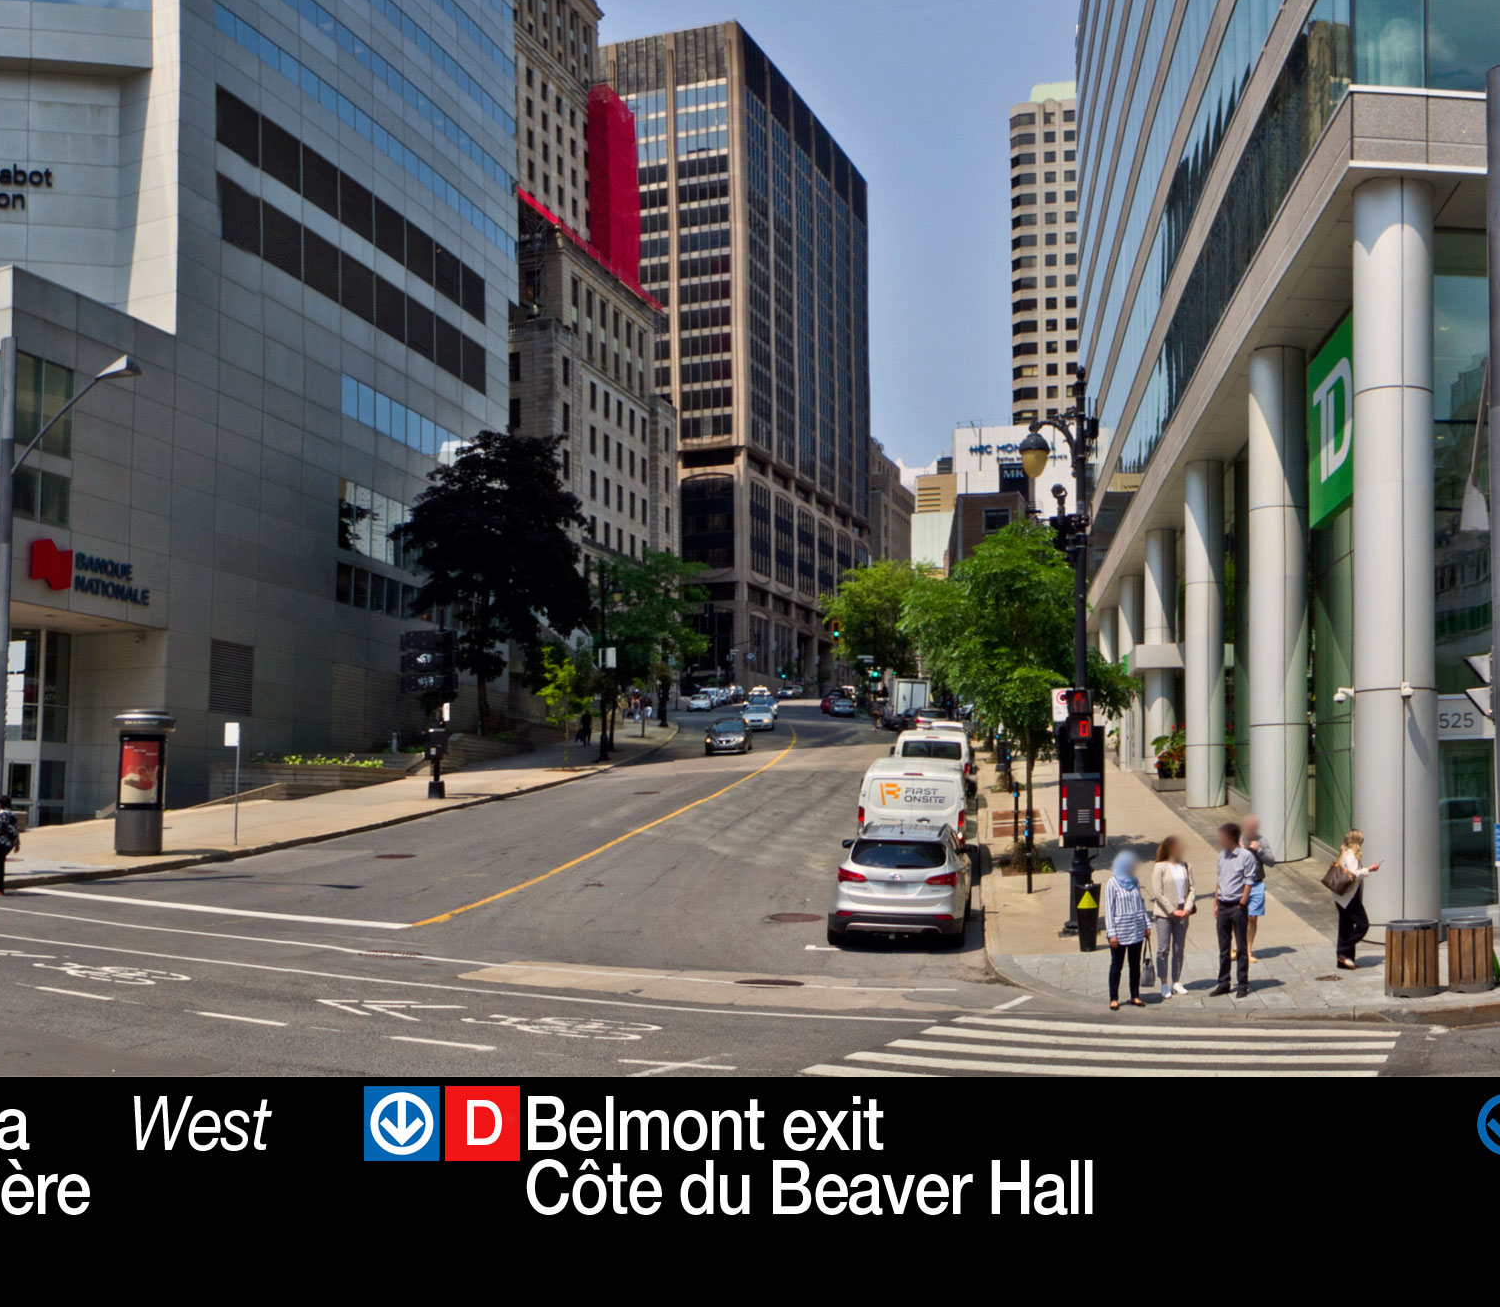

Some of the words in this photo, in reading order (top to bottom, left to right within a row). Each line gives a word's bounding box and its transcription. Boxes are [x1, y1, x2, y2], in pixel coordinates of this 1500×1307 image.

[1313, 357, 1353, 484] TD
[75, 552, 133, 581] BANQUE
[74, 575, 150, 606] NATIONALE
[1439, 712, 1474, 729] 525
[904, 795, 946, 804] ONSITE
[905, 787, 938, 795] FIRST
